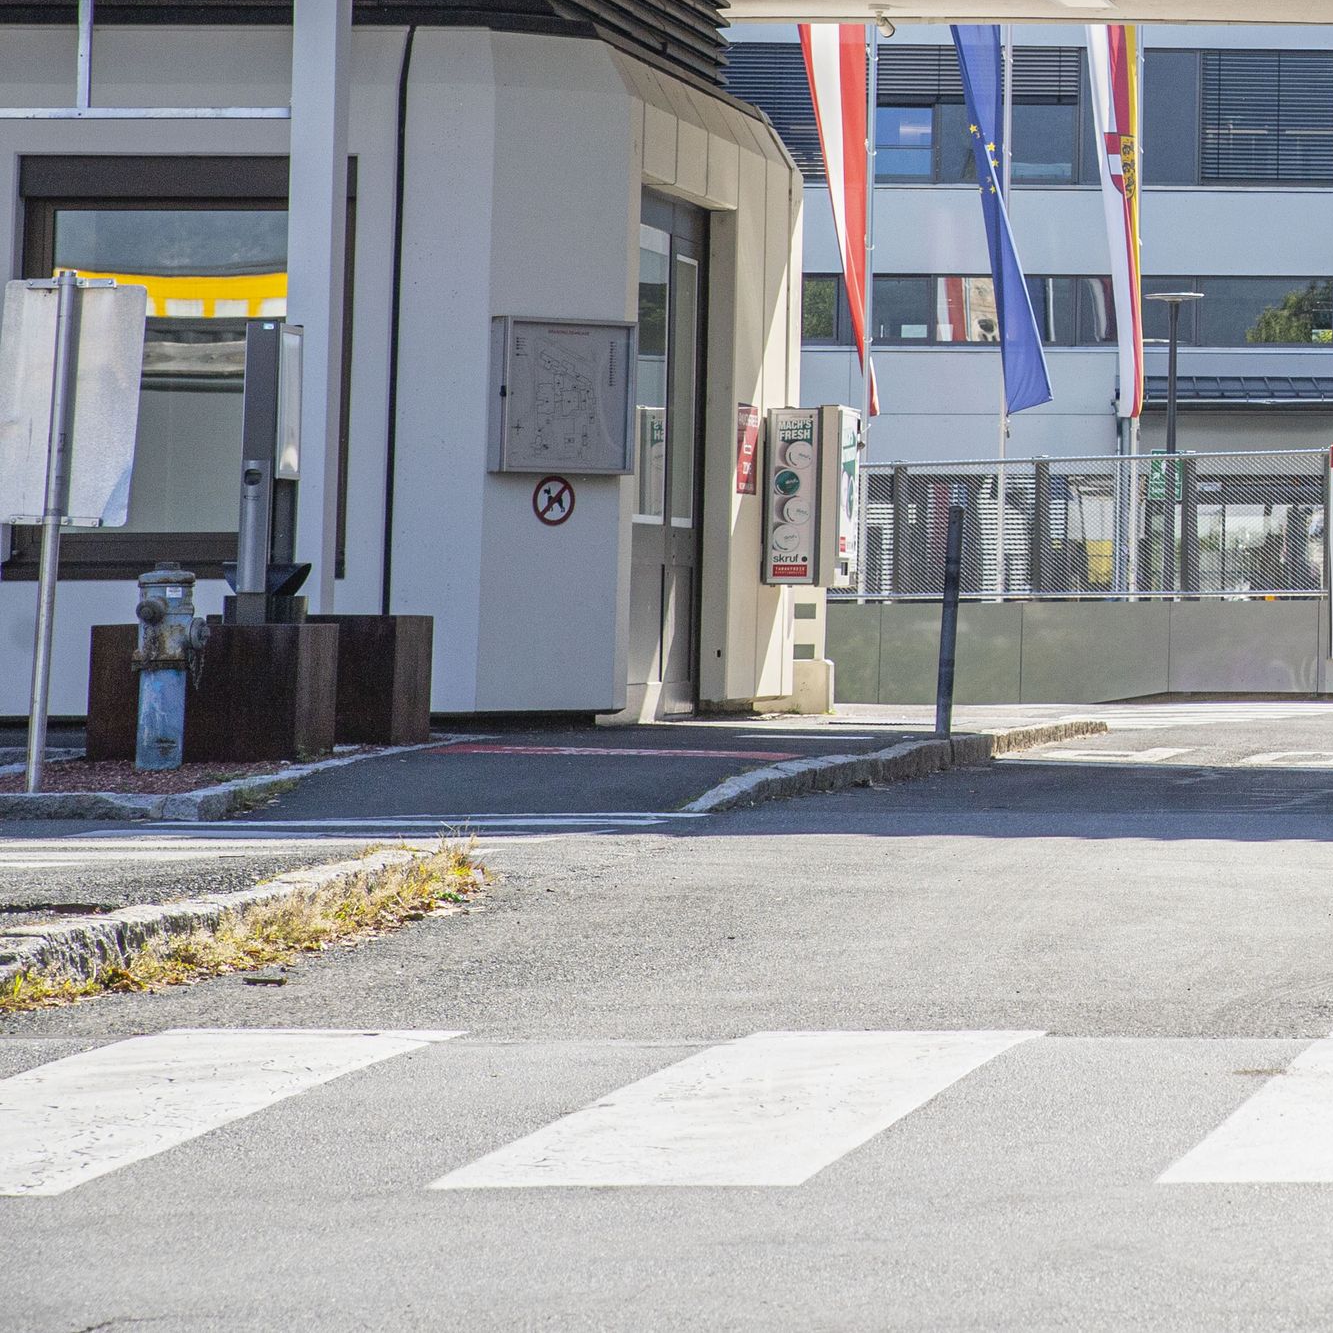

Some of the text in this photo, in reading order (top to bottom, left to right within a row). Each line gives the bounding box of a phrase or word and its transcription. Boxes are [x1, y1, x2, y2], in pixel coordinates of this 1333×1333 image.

[779, 418, 812, 430] MACH'S
[779, 429, 811, 441] FRESH
[773, 554, 798, 562] skruf
